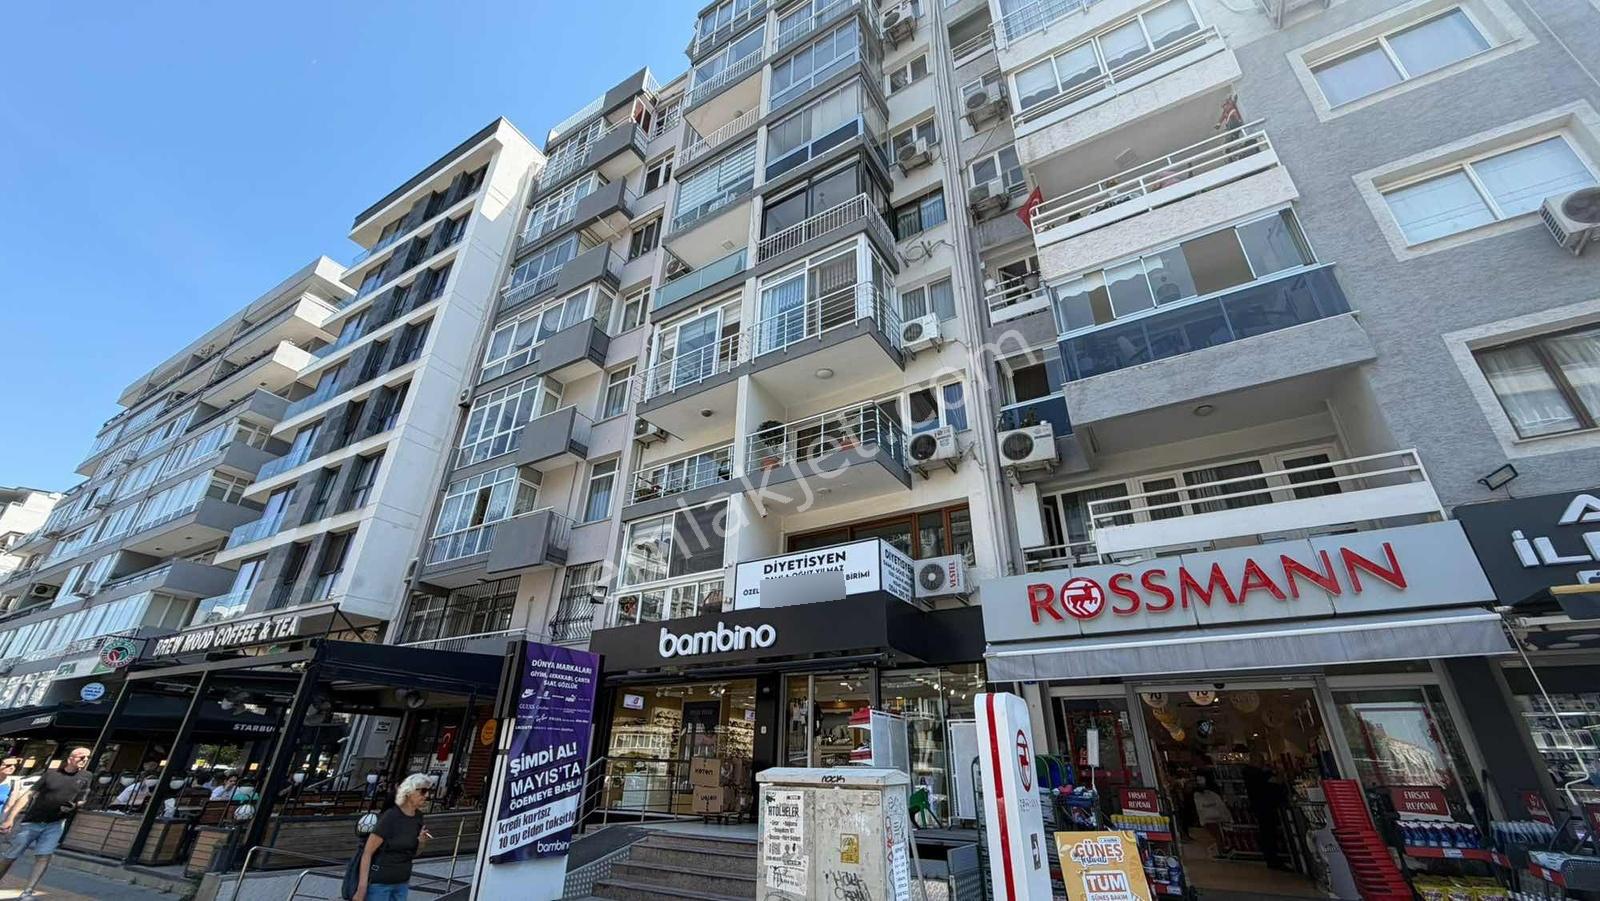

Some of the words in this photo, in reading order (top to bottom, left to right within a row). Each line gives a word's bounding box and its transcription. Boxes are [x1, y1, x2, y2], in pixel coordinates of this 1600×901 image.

[763, 551, 847, 575] DİYETİSYEN
[948, 560, 957, 588] VESTEL
[743, 588, 760, 597] ÖZEL
[1026, 541, 1407, 625] ROSSMANN
[152, 637, 184, 656] BREW
[181, 629, 215, 651] MOOD
[214, 622, 261, 647] COFFEE
[258, 622, 271, 640] &
[271, 615, 298, 639] TEA
[658, 620, 777, 658] bambino
[531, 658, 555, 669] DÜNYA
[555, 662, 592, 674] MARKALARI
[232, 723, 275, 733] STARBU
[510, 745, 553, 778] ŞİMDİ
[556, 741, 578, 760] AL!
[510, 761, 581, 798] MAYIS'TA
[509, 787, 553, 811] ÖDEMEYE
[498, 816, 522, 835] kredi
[522, 806, 552, 825] kartsız
[498, 836, 508, 849] 10
[509, 832, 521, 846] ay
[522, 824, 544, 841] elden
[537, 840, 570, 853] bambin
[1074, 840, 1123, 861] GÜNEŞ
